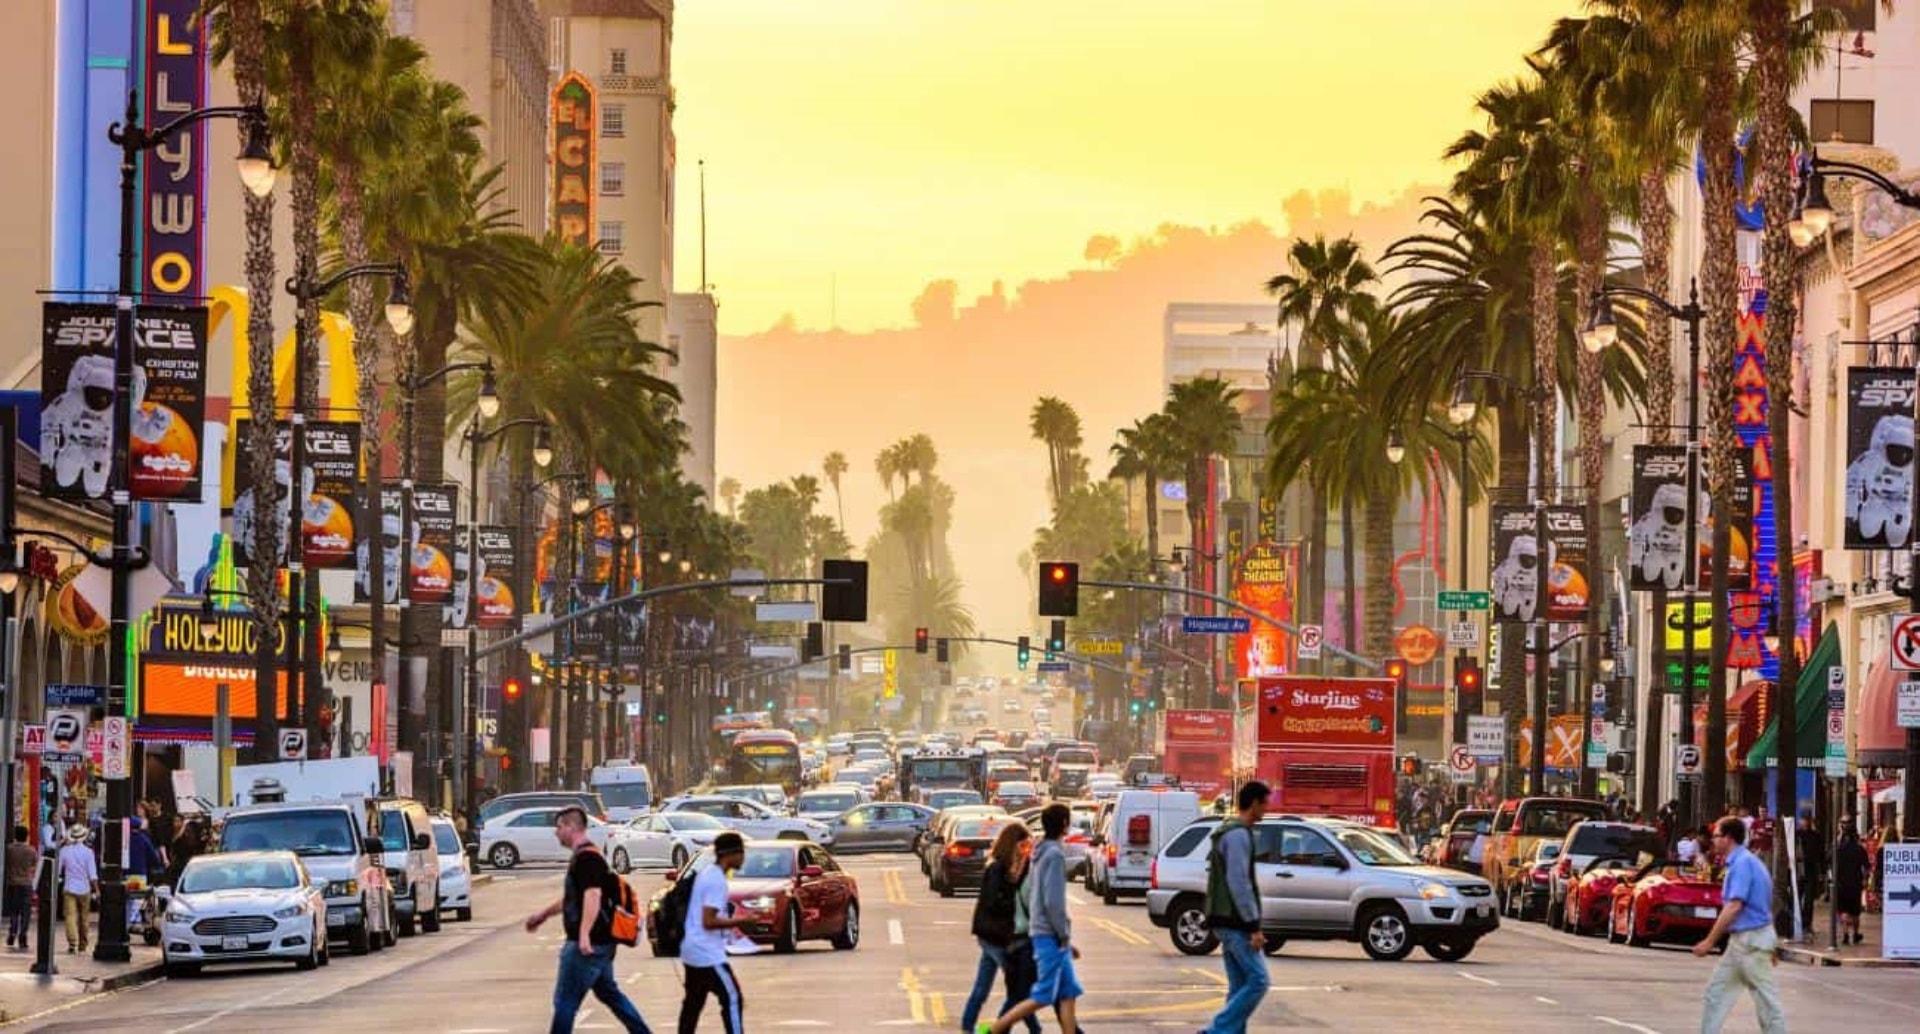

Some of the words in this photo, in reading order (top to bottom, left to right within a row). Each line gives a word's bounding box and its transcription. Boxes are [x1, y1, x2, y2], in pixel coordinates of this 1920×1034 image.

[1188, 619, 1228, 630] Highland
[1233, 619, 1245, 629] Av
[47, 686, 95, 697] McCadden
[1291, 689, 1361, 709] Starline
